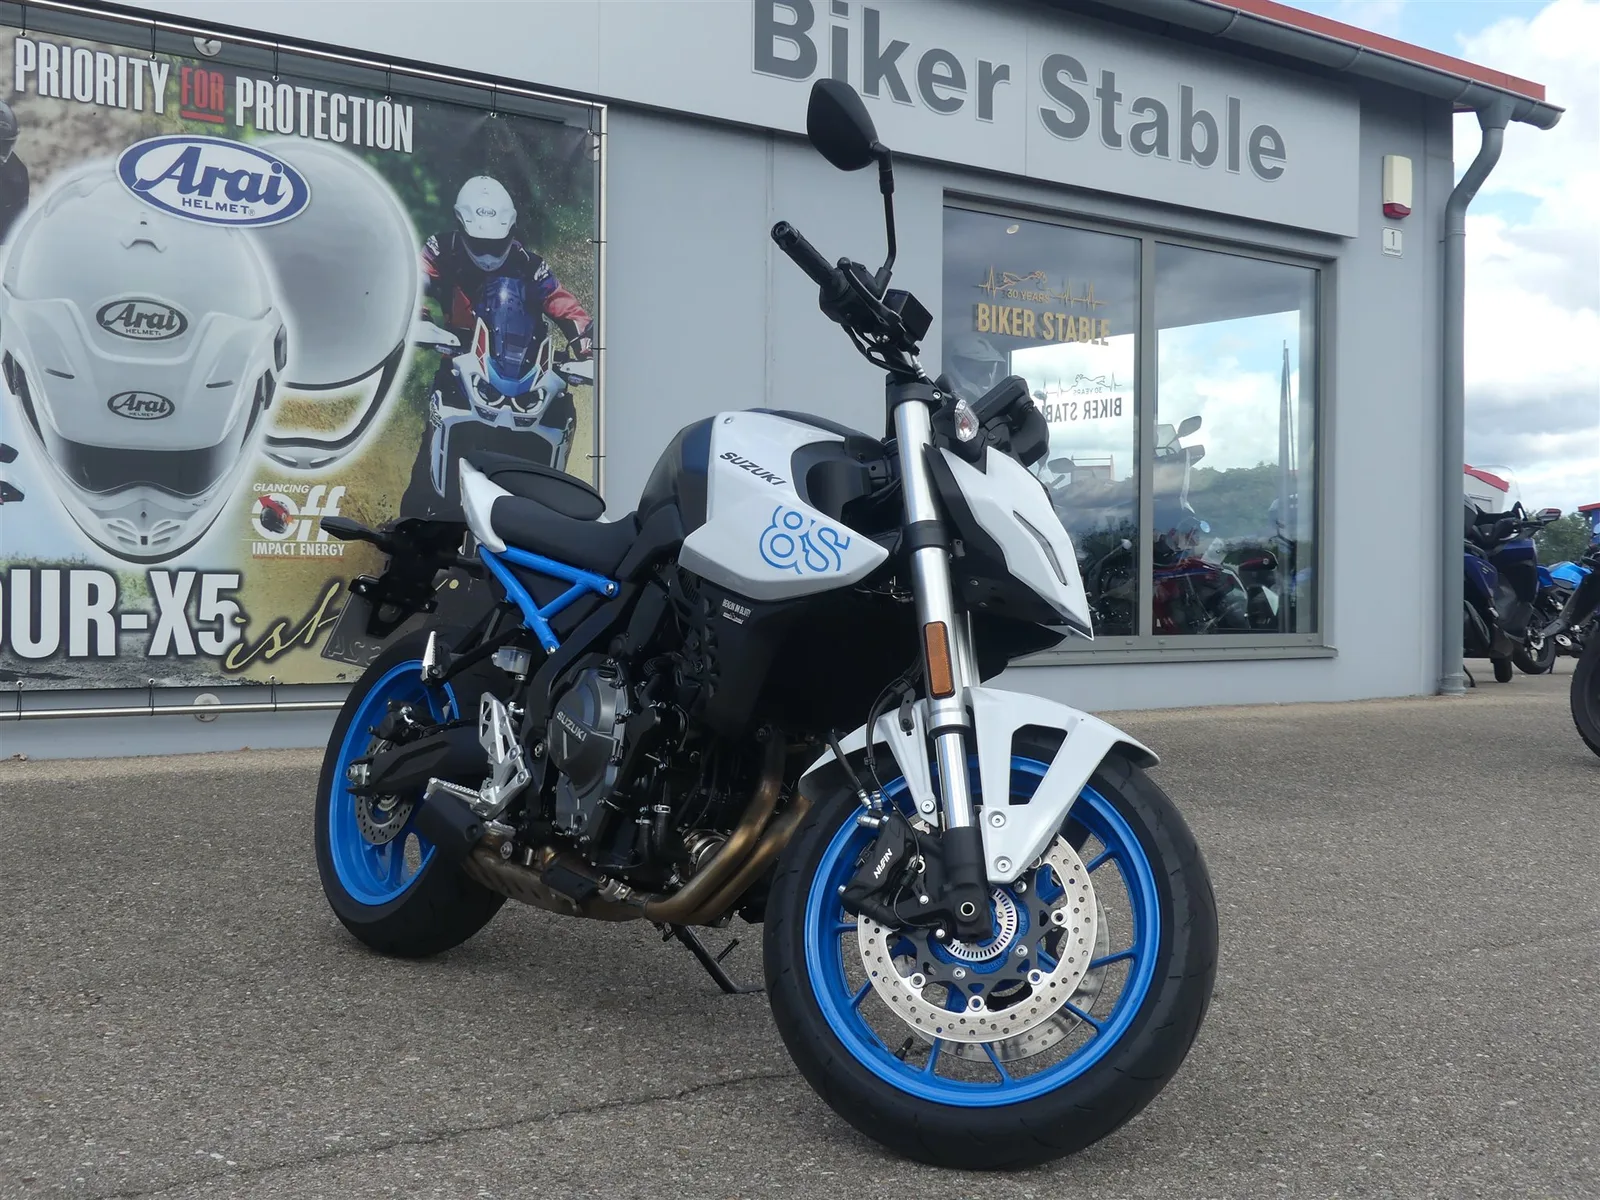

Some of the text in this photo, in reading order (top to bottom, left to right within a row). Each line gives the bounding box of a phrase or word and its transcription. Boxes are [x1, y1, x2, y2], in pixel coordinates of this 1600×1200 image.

[15, 37, 413, 154] PRIORITY FOR PROTECTION
[752, 0, 1287, 181] Biker Stable
[131, 145, 286, 206] Arai
[182, 197, 250, 214] HELMET
[1007, 288, 1050, 304] 30 YEARS
[102, 303, 177, 331] Arai
[125, 328, 160, 336] HELMET
[977, 303, 1110, 346] BIKER STABLE
[113, 393, 168, 413] Arai
[719, 451, 787, 486] SUZUKI
[253, 482, 310, 494] GLANCING
[251, 484, 346, 542] Off
[252, 542, 345, 556] IMPACT ENERGY
[0, 568, 242, 659] UR-X5
[556, 711, 587, 742] SUZUKI
